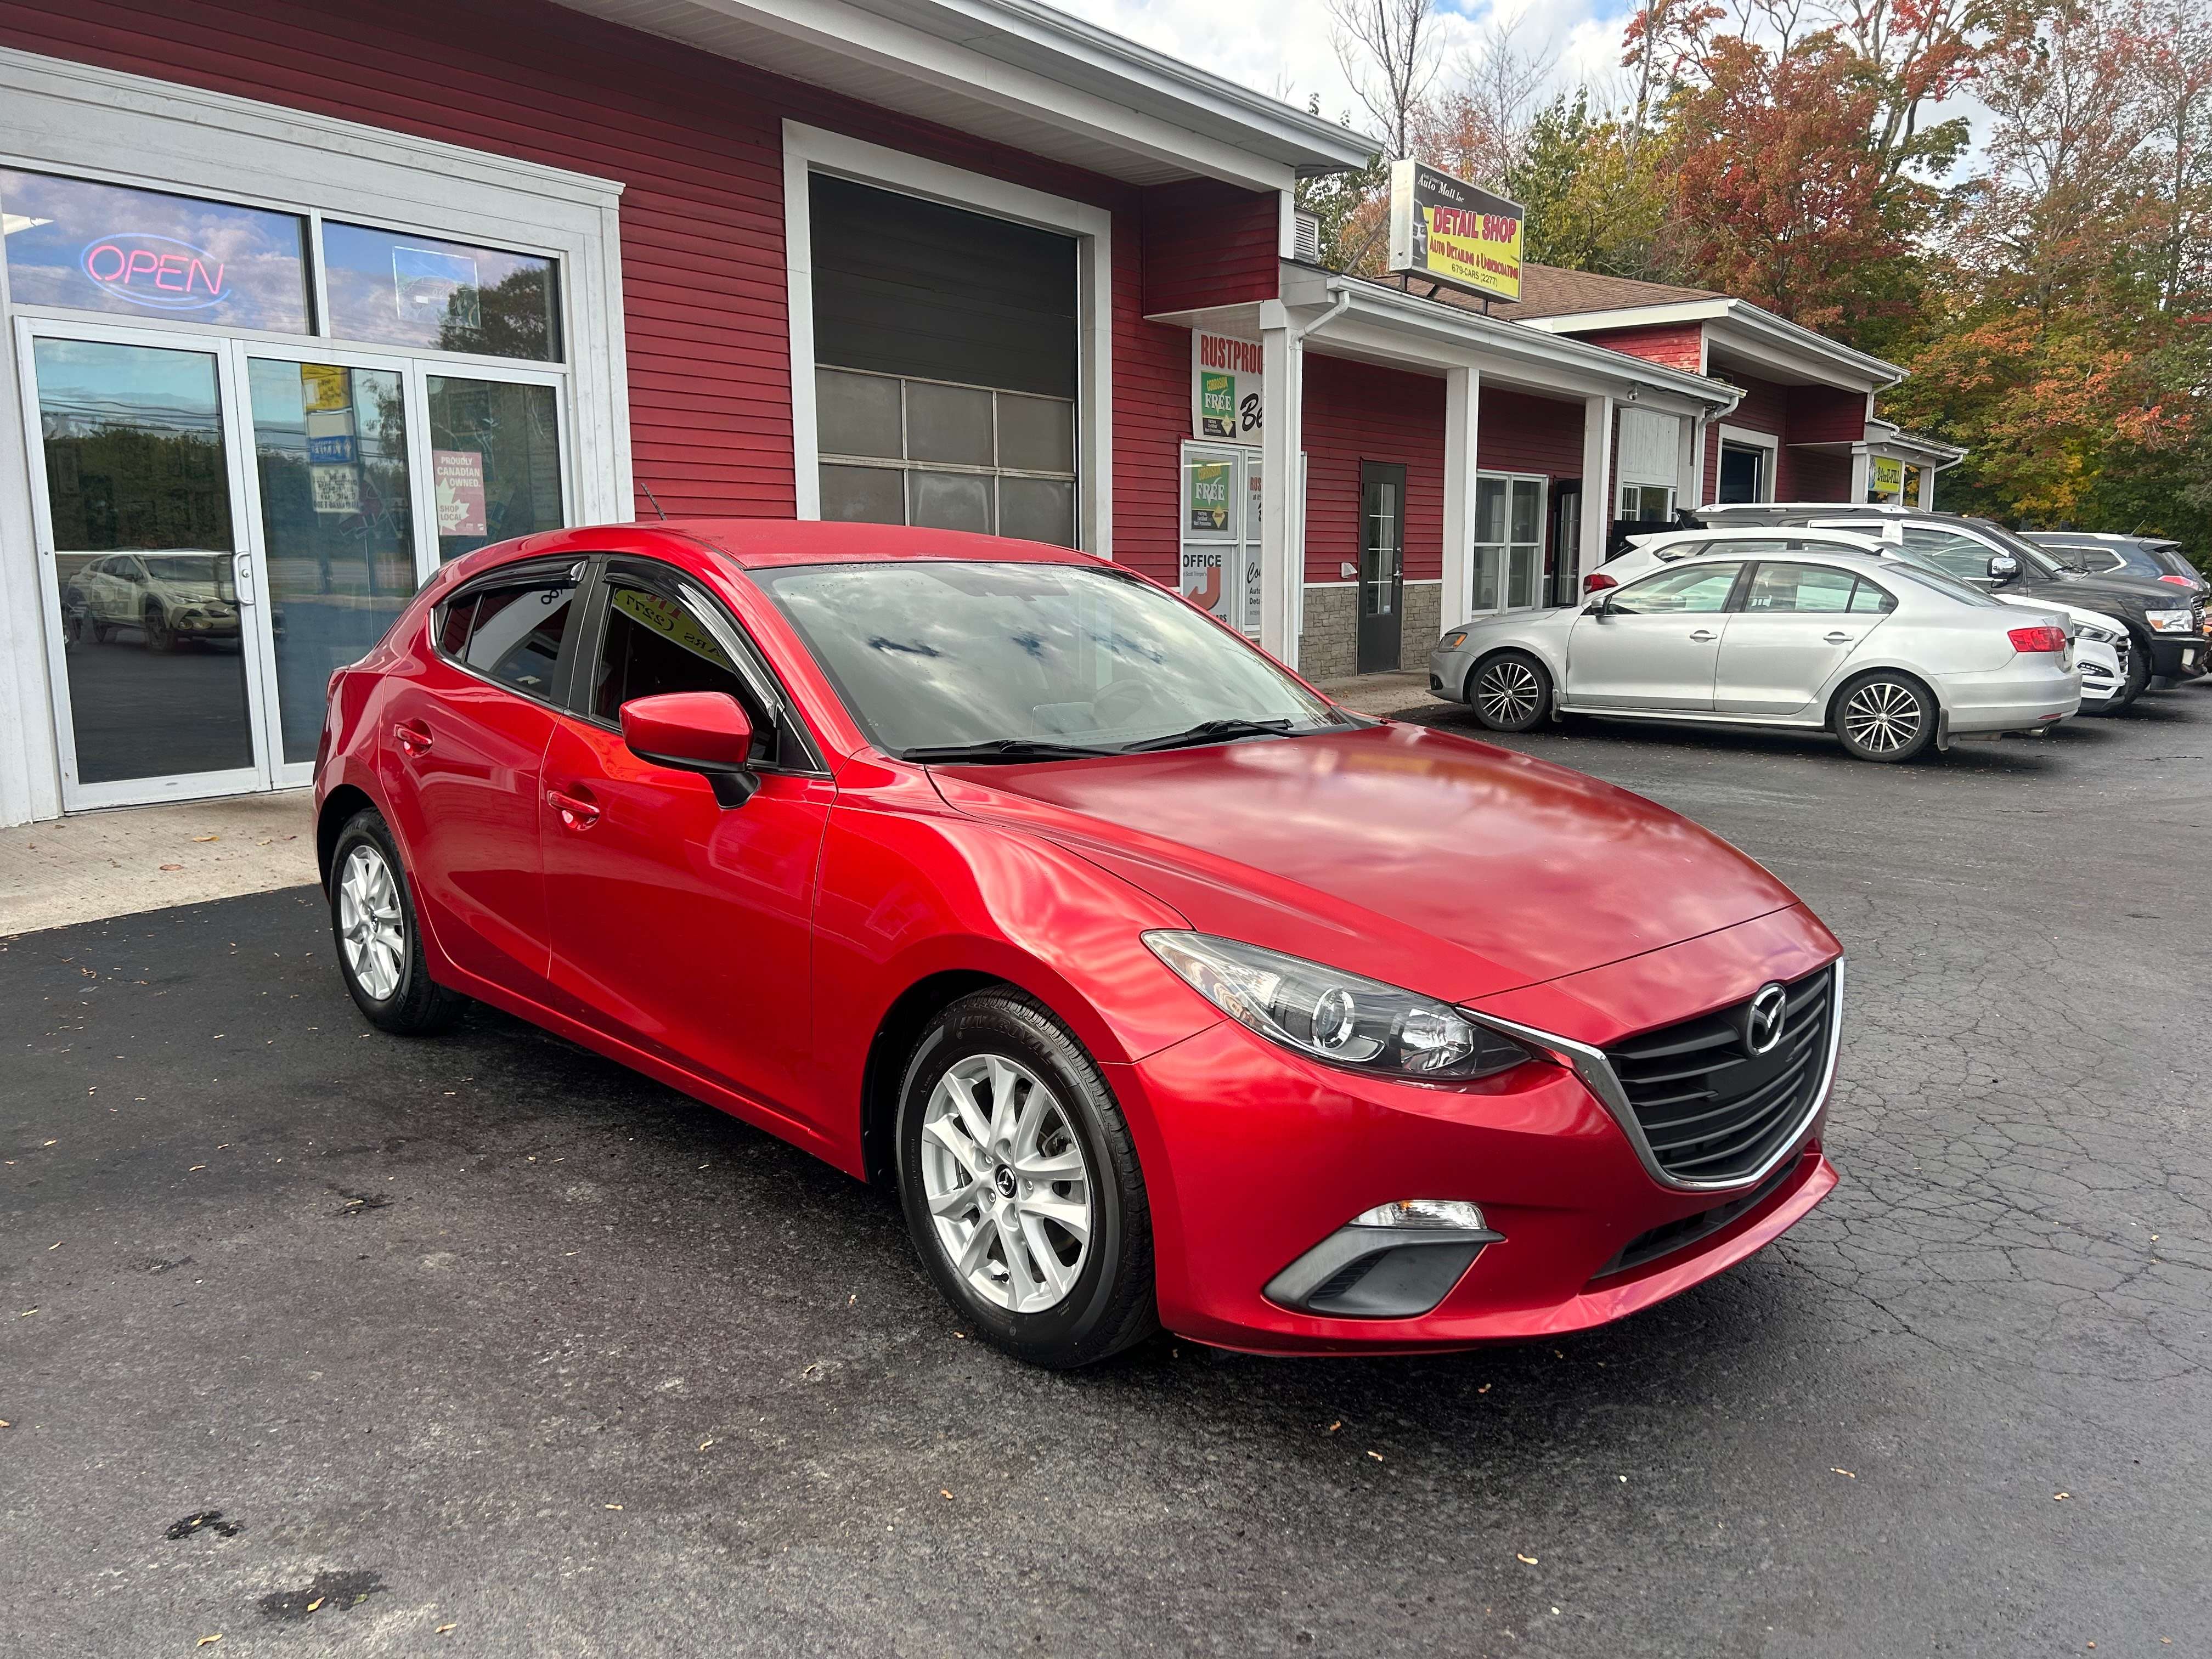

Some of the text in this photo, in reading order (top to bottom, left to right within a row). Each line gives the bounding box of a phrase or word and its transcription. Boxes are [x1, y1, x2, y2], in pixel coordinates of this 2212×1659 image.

[1418, 173, 1436, 191] Auto
[1438, 182, 1455, 199] Mall
[1456, 192, 1464, 202] Inc
[1432, 204, 1517, 244] DETAIL SHOP
[88, 245, 224, 295] OPEN
[1452, 263, 1498, 286] 679-CARS (2277)
[1200, 334, 1263, 375] RUSTPROO
[1204, 392, 1232, 411] FREE
[1240, 393, 1263, 432] Be
[441, 456, 473, 466] PROUDLY
[437, 467, 481, 477] CANADIAN
[449, 478, 481, 488] OWNED.
[1195, 483, 1225, 501] FREE
[1250, 477, 1261, 492] RUS
[1183, 554, 1222, 567] OFFICE
